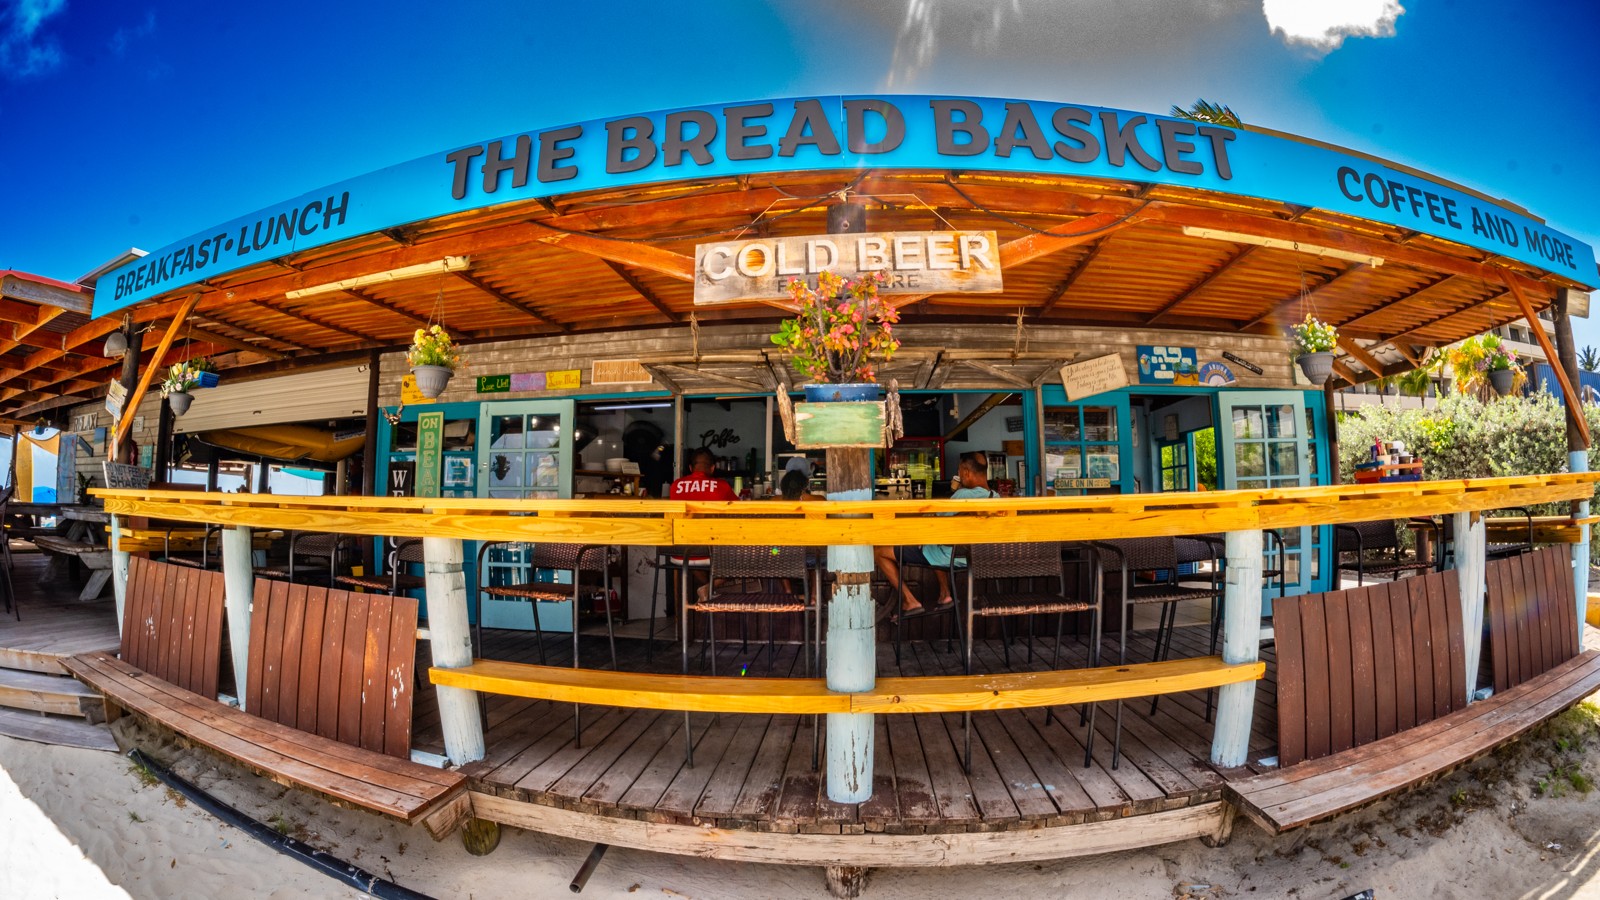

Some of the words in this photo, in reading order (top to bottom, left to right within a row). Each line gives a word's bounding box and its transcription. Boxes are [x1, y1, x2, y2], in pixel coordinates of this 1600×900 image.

[446, 125, 583, 200] THE
[605, 99, 905, 174] BREAD
[929, 99, 1236, 181] BASKET
[1336, 165, 1462, 230] COFFEE
[1471, 206, 1519, 248] AND
[1523, 226, 1577, 270] MORE
[114, 232, 228, 301] BREAKFAST
[236, 191, 349, 257] LUNCH
[701, 238, 840, 282] COLD
[856, 234, 995, 272] BEER
[74, 413, 97, 432] RELAX
[422, 418, 438, 430] ON
[699, 428, 741, 448] Coffee
[422, 432, 435, 498] BEAC
[109, 475, 148, 488] SHARKS
[676, 480, 718, 493] STAFF
[1055, 479, 1073, 488] COME
[1076, 479, 1085, 487] ON
[1086, 479, 1093, 487] IN
